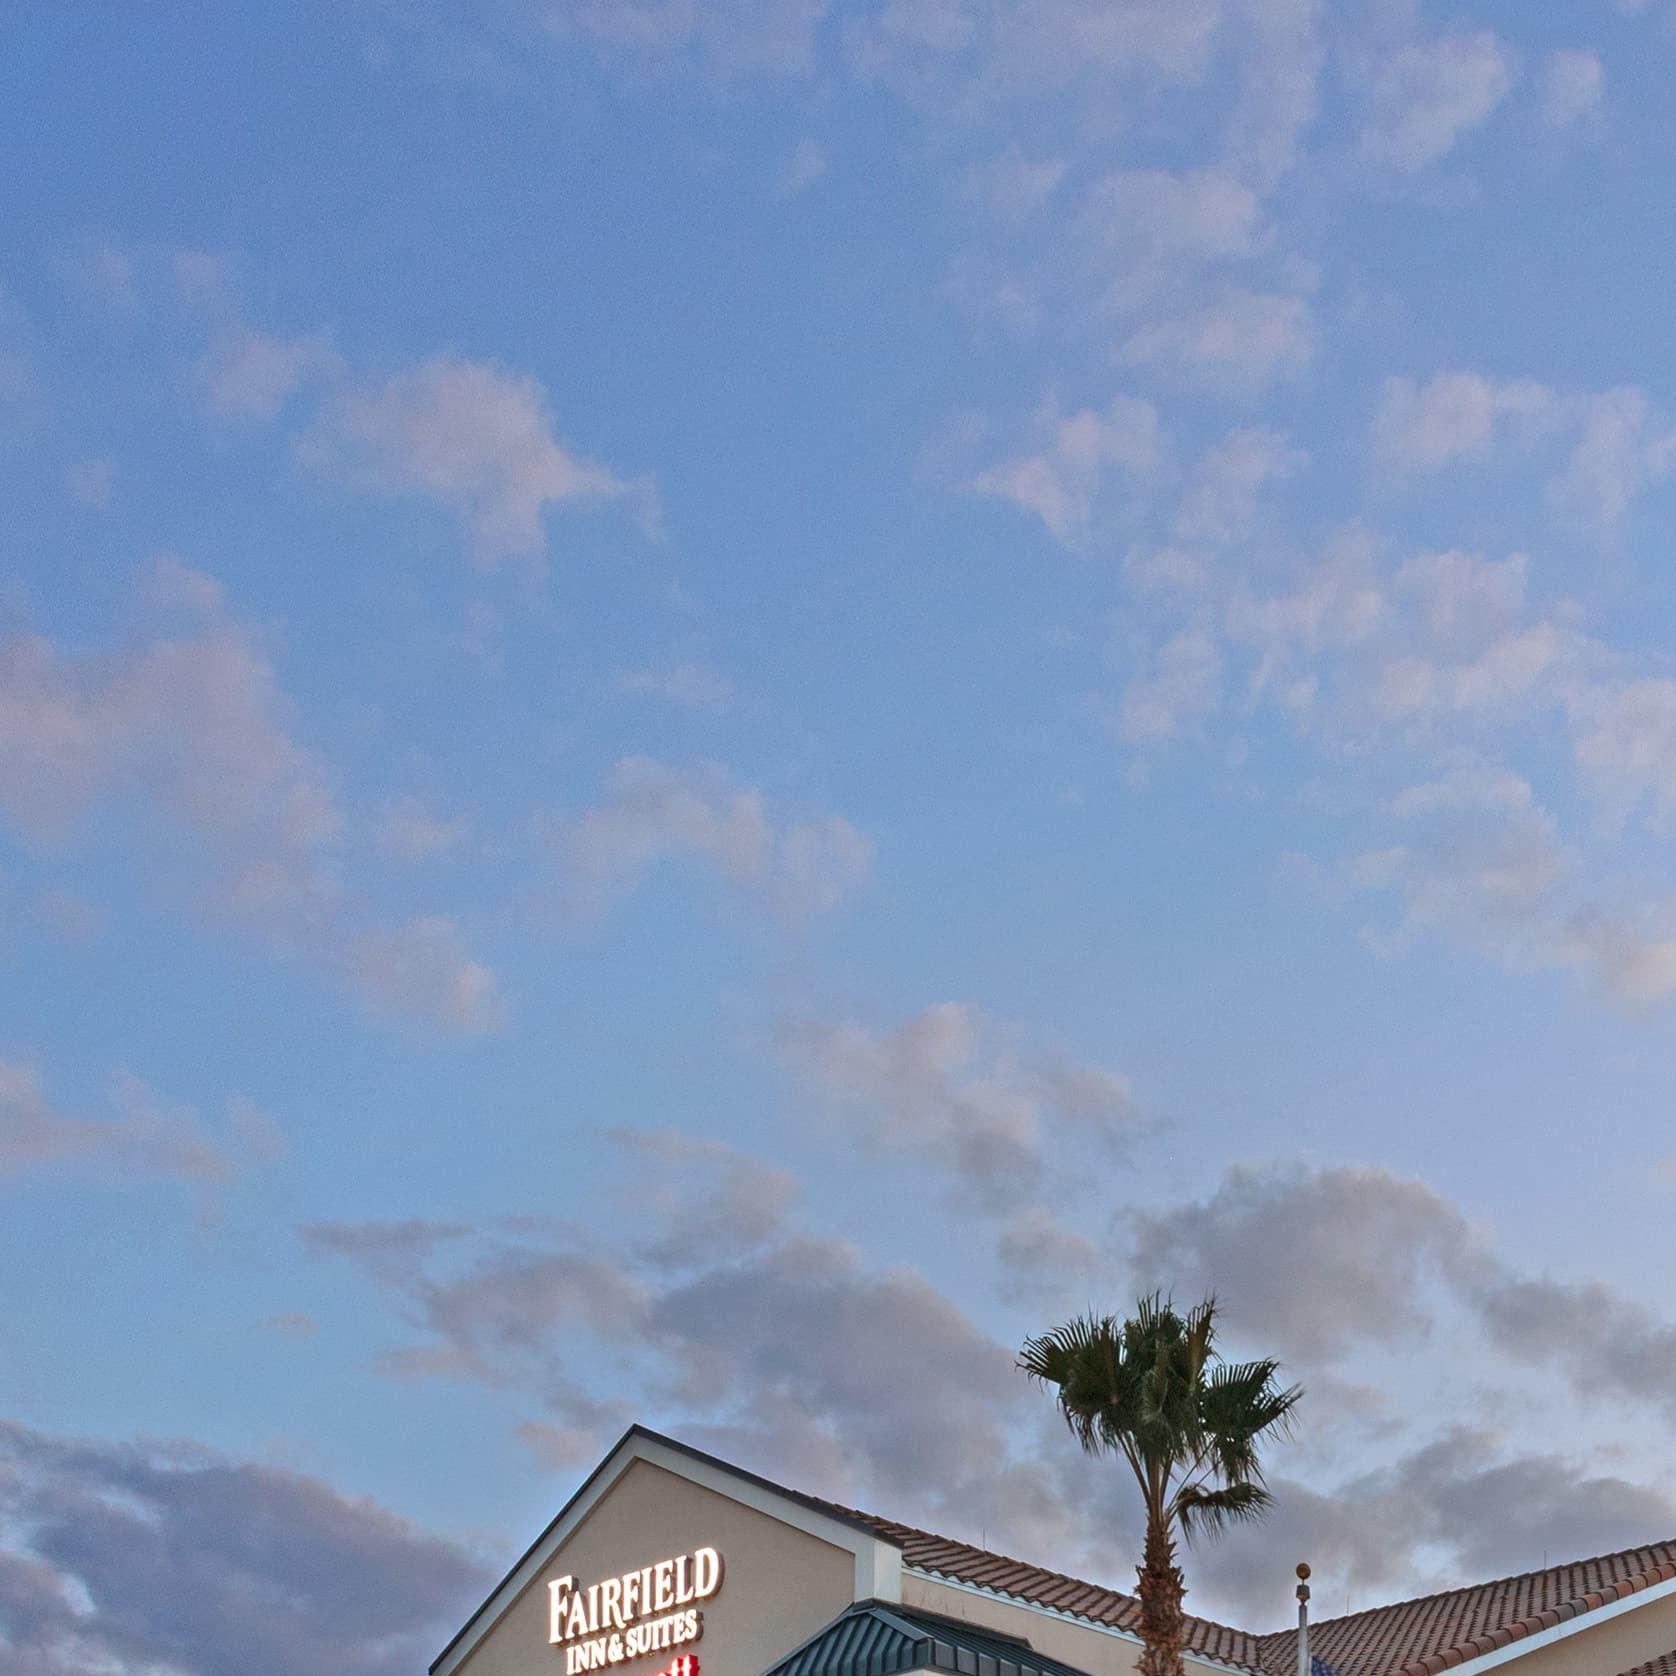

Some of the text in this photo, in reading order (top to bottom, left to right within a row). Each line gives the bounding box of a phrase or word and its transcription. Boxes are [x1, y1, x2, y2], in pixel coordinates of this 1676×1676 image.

[548, 1547, 722, 1645] FAIRFIELD
[566, 1639, 608, 1676] INN
[625, 1609, 700, 1659] SUITES
